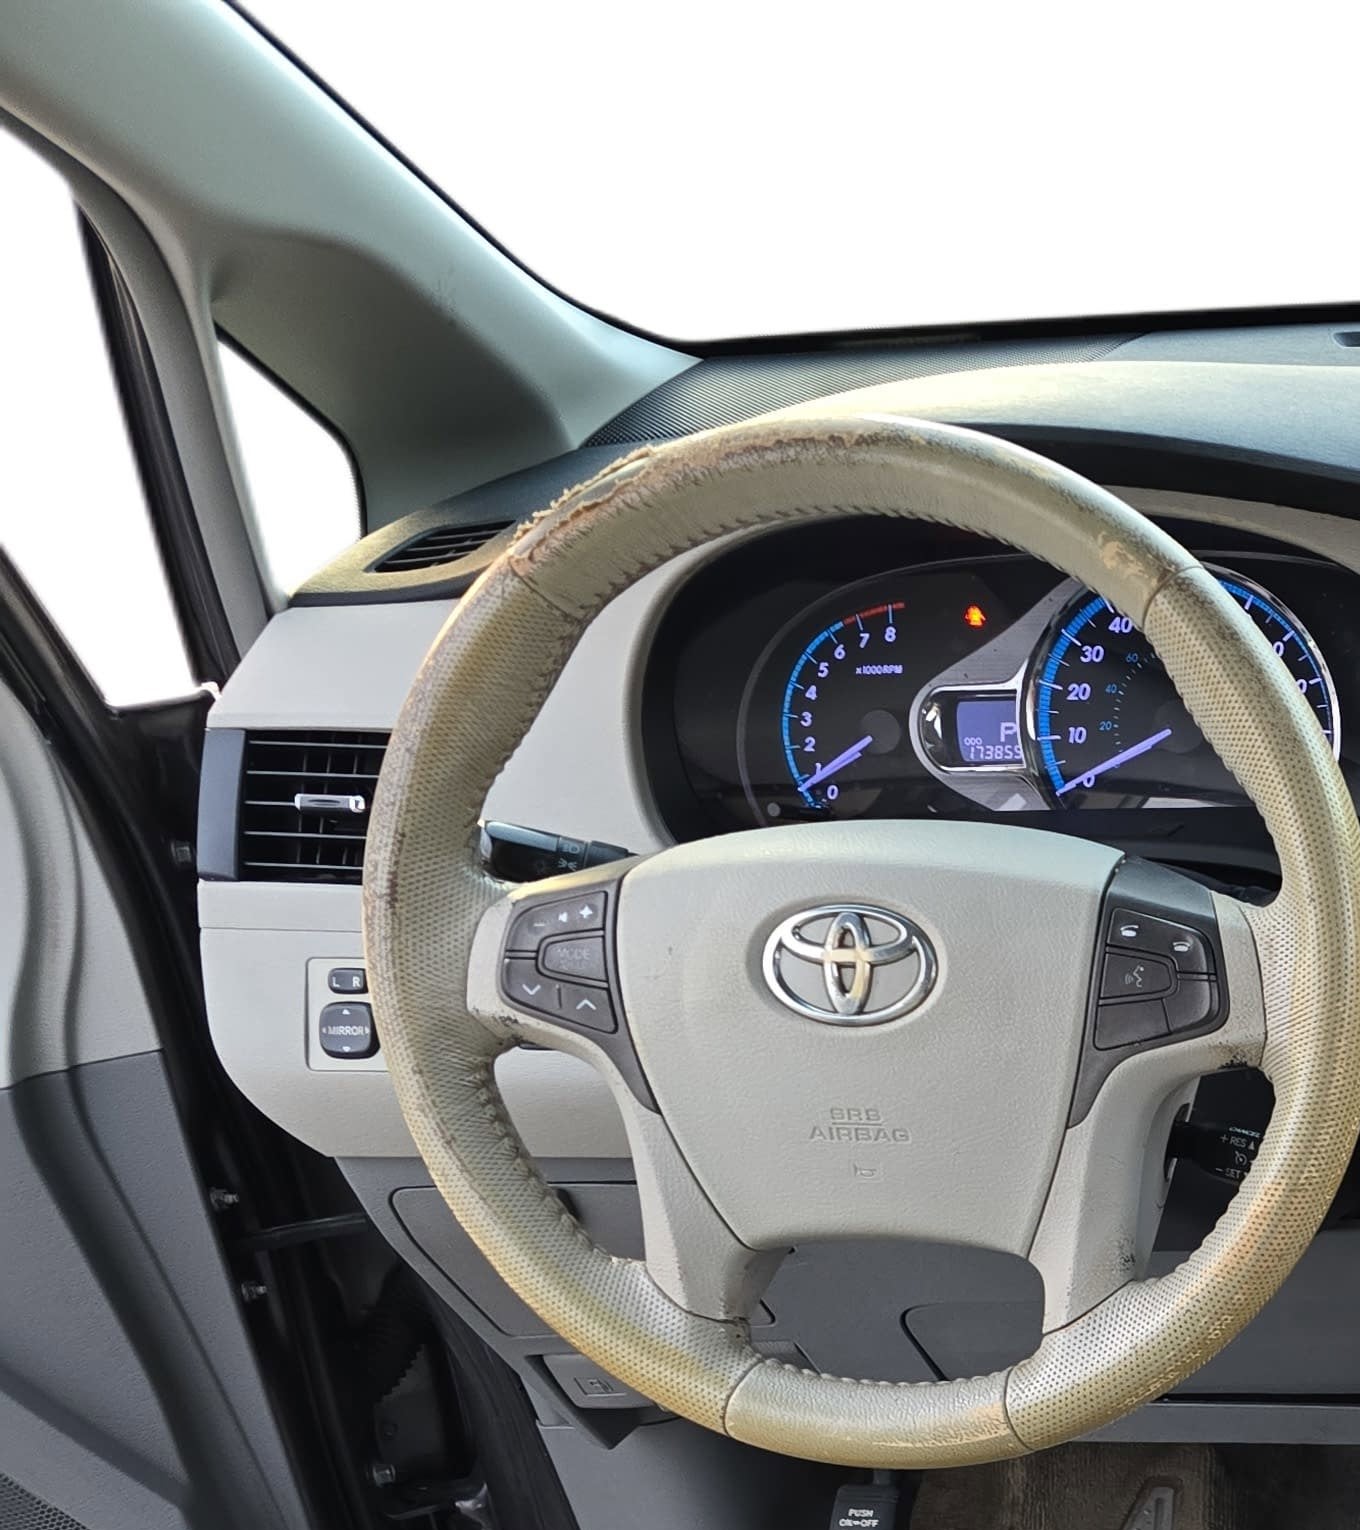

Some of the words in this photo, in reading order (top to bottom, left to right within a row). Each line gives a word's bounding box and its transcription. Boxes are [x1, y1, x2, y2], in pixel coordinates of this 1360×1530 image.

[1108, 617, 1132, 634] 40
[858, 632, 870, 649] 7
[884, 626, 896, 642] 8
[833, 644, 846, 660] 6
[1080, 645, 1104, 663] 30
[818, 661, 829, 678] 5
[804, 684, 818, 701] 4
[1067, 683, 1091, 701] 20
[1104, 683, 1118, 695] 40
[800, 711, 812, 727] 3
[1099, 720, 1112, 731] 20
[1000, 722, 1017, 742] P
[1068, 727, 1087, 745] 10
[803, 736, 816, 752] 2
[826, 784, 839, 800] 0
[332, 975, 341, 988] L
[352, 975, 361, 988] R
[327, 1024, 364, 1037] MIRROR
[829, 1107, 883, 1121] SRS
[809, 1126, 911, 1142] AIRBAG
[1229, 1135, 1247, 1148] RES
